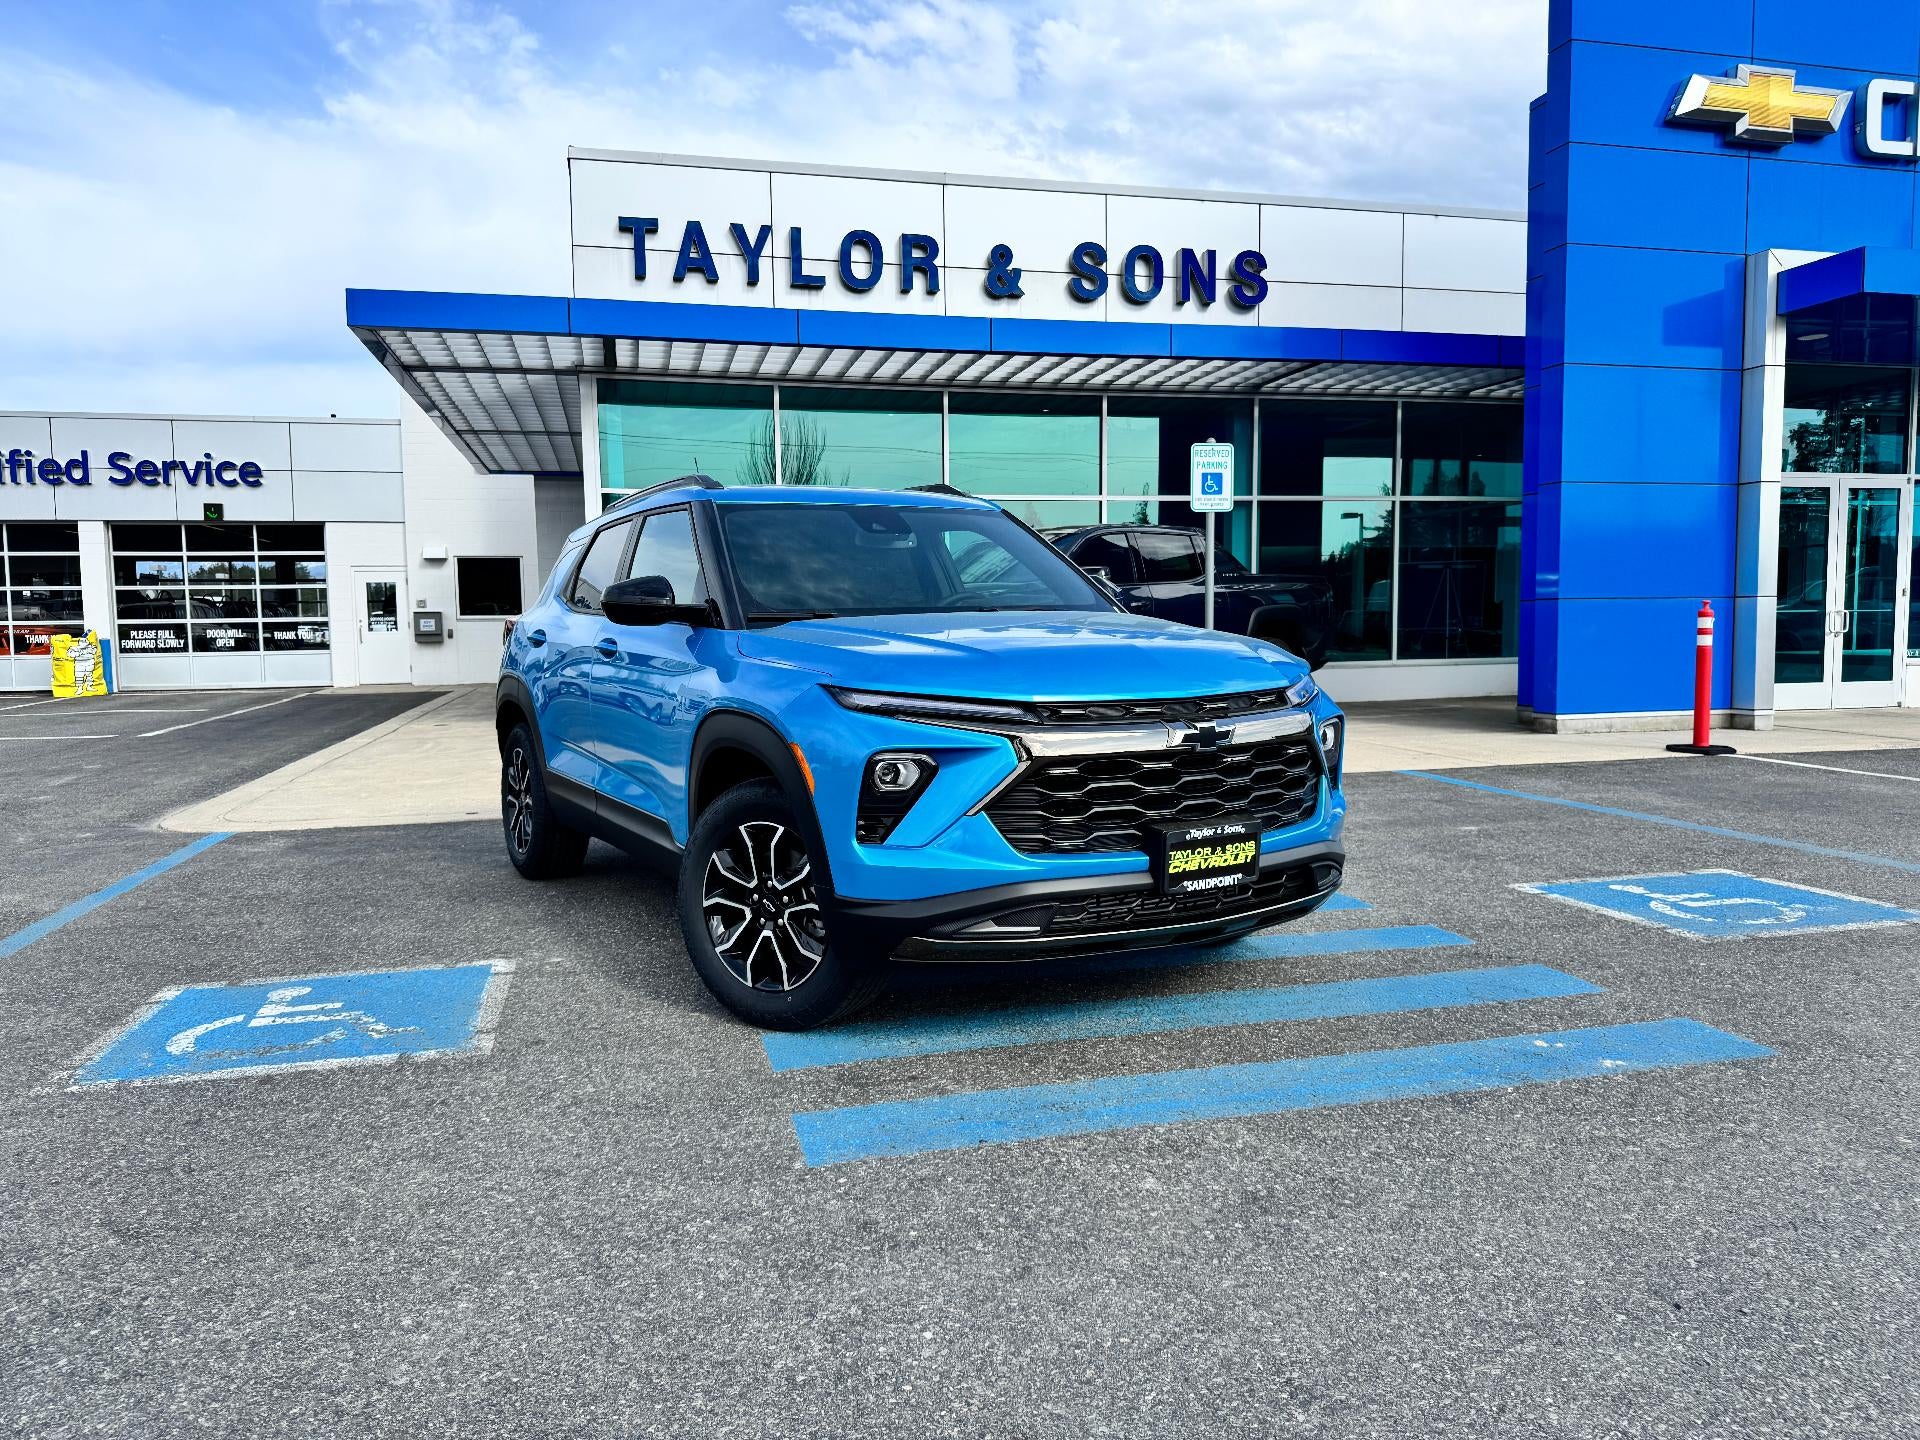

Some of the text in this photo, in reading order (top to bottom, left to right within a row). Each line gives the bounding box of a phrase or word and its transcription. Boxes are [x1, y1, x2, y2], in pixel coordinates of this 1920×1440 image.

[618, 216, 1270, 308] TAYLOR & SONS
[1194, 449, 1230, 458] RESERVED
[107, 451, 263, 487] Service
[1196, 460, 1228, 470] PARKING
[130, 630, 175, 639] PLEASE PULL
[206, 629, 243, 638] DOOR WILL
[274, 631, 297, 640] THANK
[25, 634, 49, 644] THANK
[121, 639, 184, 648] FORWARD SLOWLY
[216, 638, 235, 647] OPEN
[1189, 828, 1216, 839] Taylor
[1223, 825, 1242, 834] Sons
[1169, 841, 1256, 861] TAYLOR & SONS
[1168, 852, 1255, 874] CHEVROLET
[1186, 877, 1238, 891] SANDPOINT
